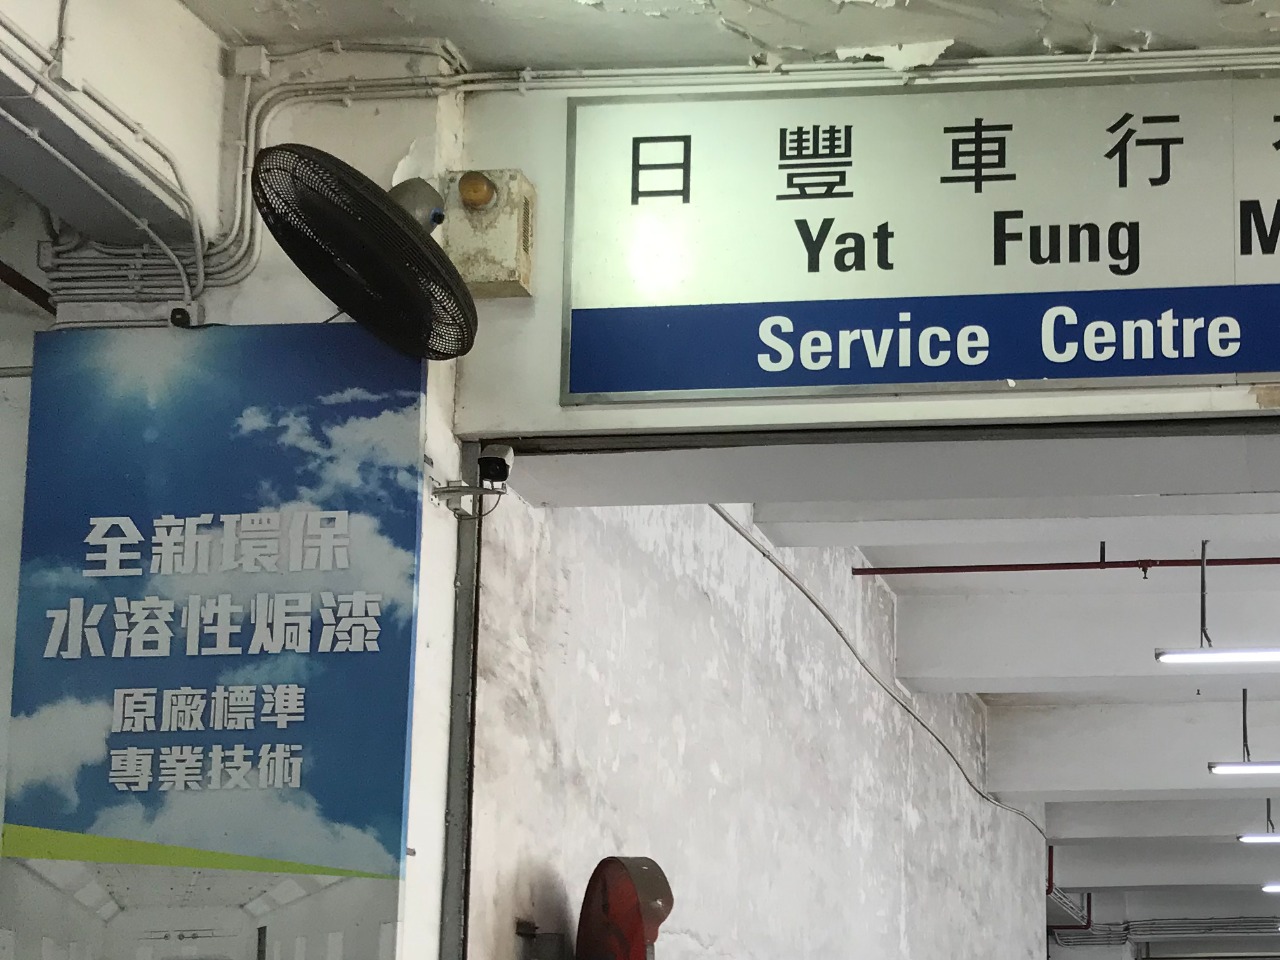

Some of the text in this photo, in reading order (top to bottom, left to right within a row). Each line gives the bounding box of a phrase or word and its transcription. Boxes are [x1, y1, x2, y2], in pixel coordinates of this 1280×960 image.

[795, 217, 895, 274] Yat
[993, 210, 1141, 276] Fung
[757, 313, 991, 373] Service
[1041, 306, 1242, 365] Centre
[83, 510, 351, 577] 全新環保
[43, 591, 382, 659] 水溶性焗漆
[111, 684, 306, 733] 原廠標準
[108, 744, 304, 792] 專業技術
